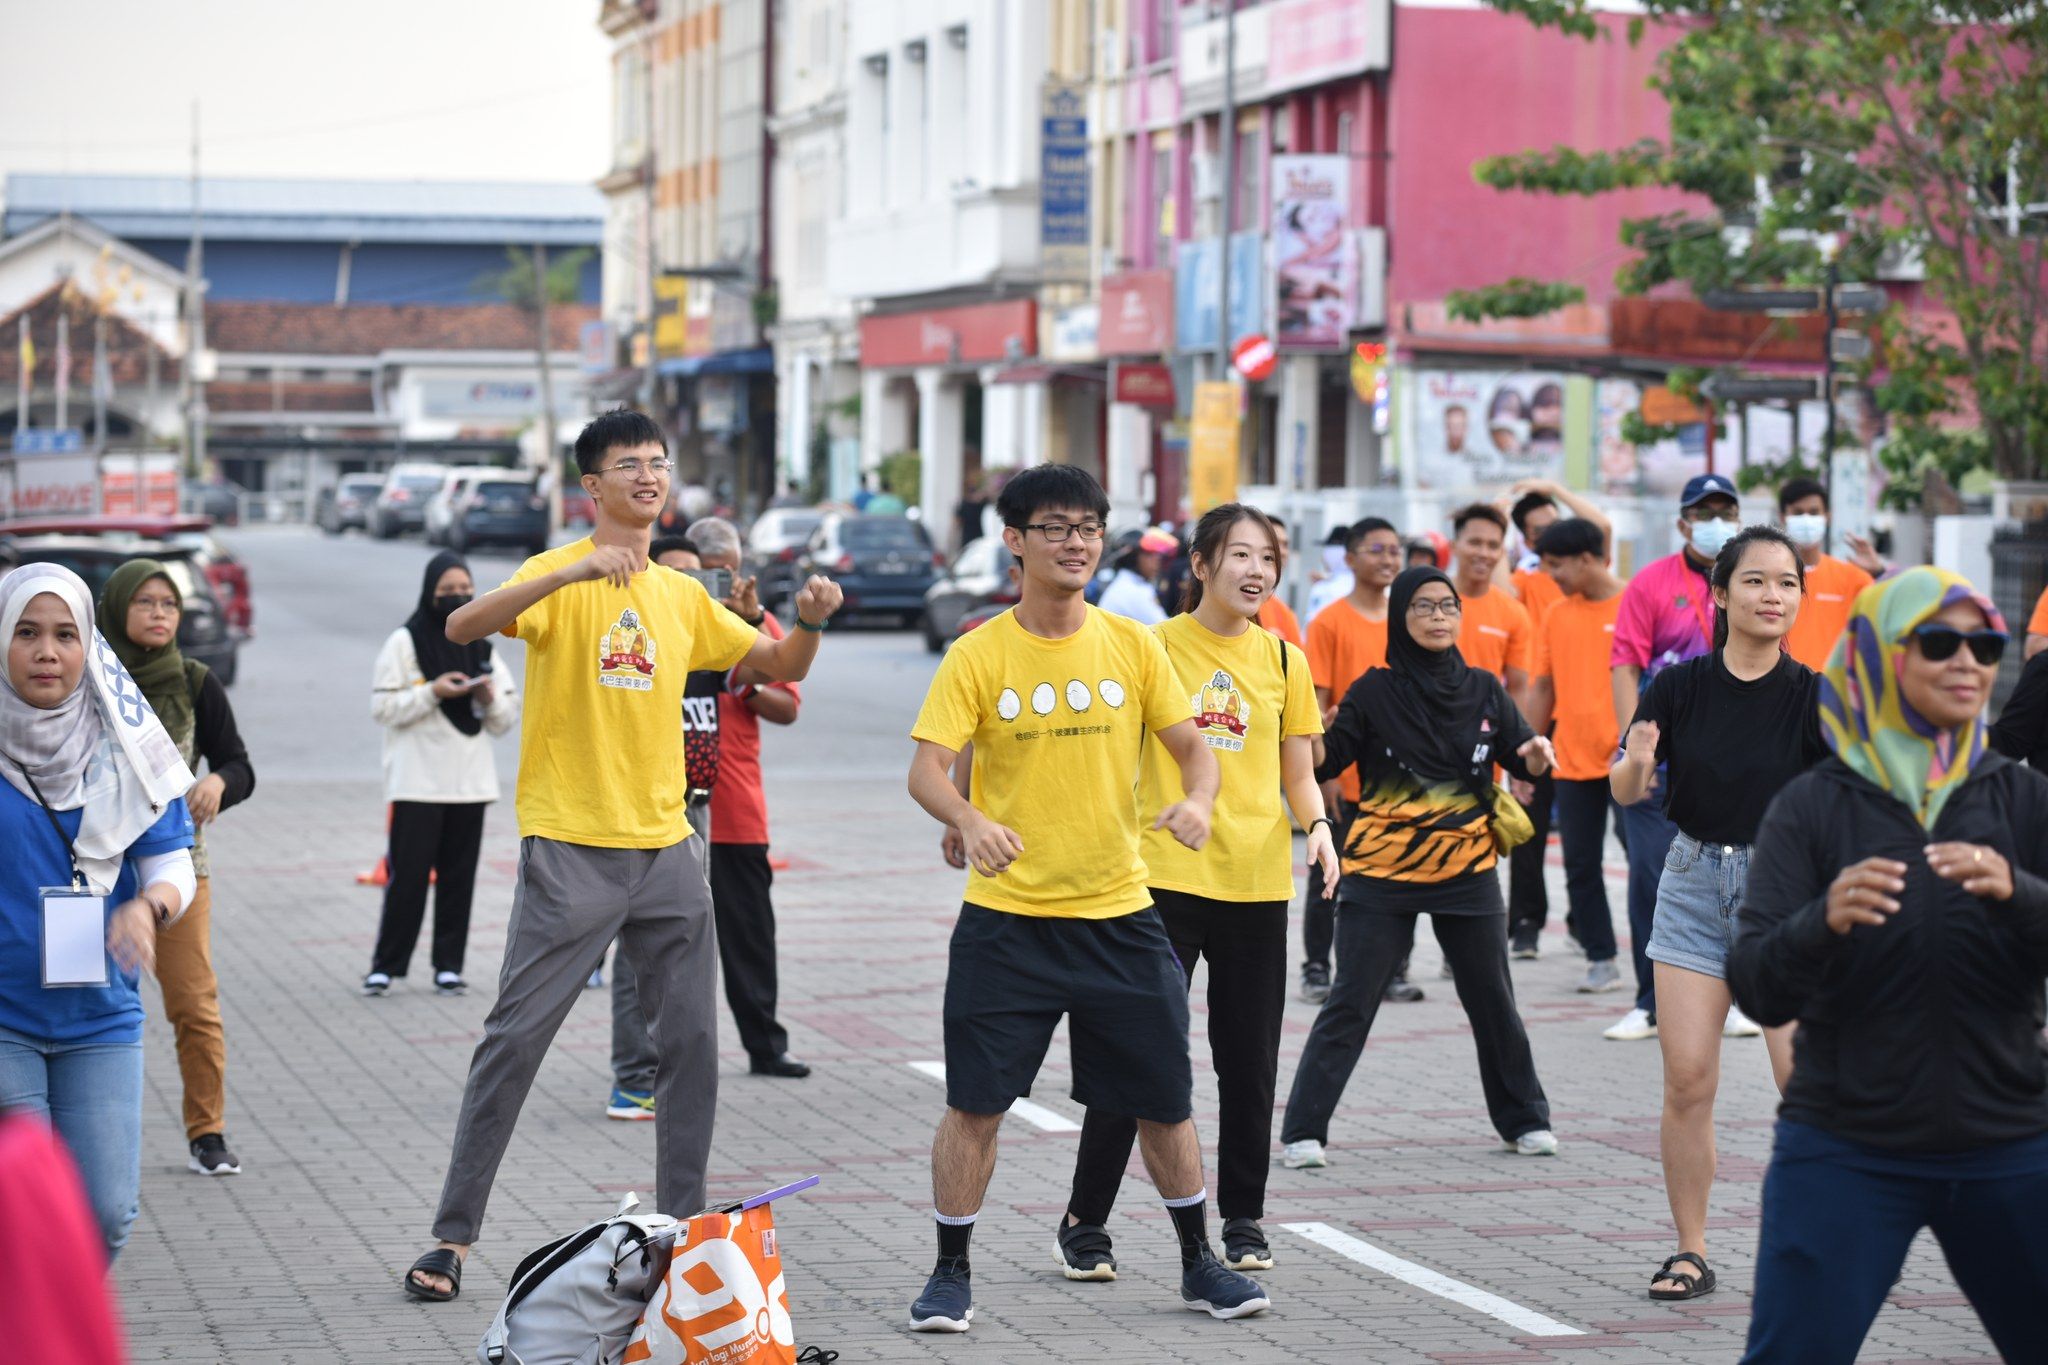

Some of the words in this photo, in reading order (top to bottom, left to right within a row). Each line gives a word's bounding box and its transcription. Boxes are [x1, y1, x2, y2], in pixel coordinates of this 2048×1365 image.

[0, 483, 93, 512] AMOVE
[709, 1347, 729, 1362] lagi
[729, 1331, 758, 1355] Murah
